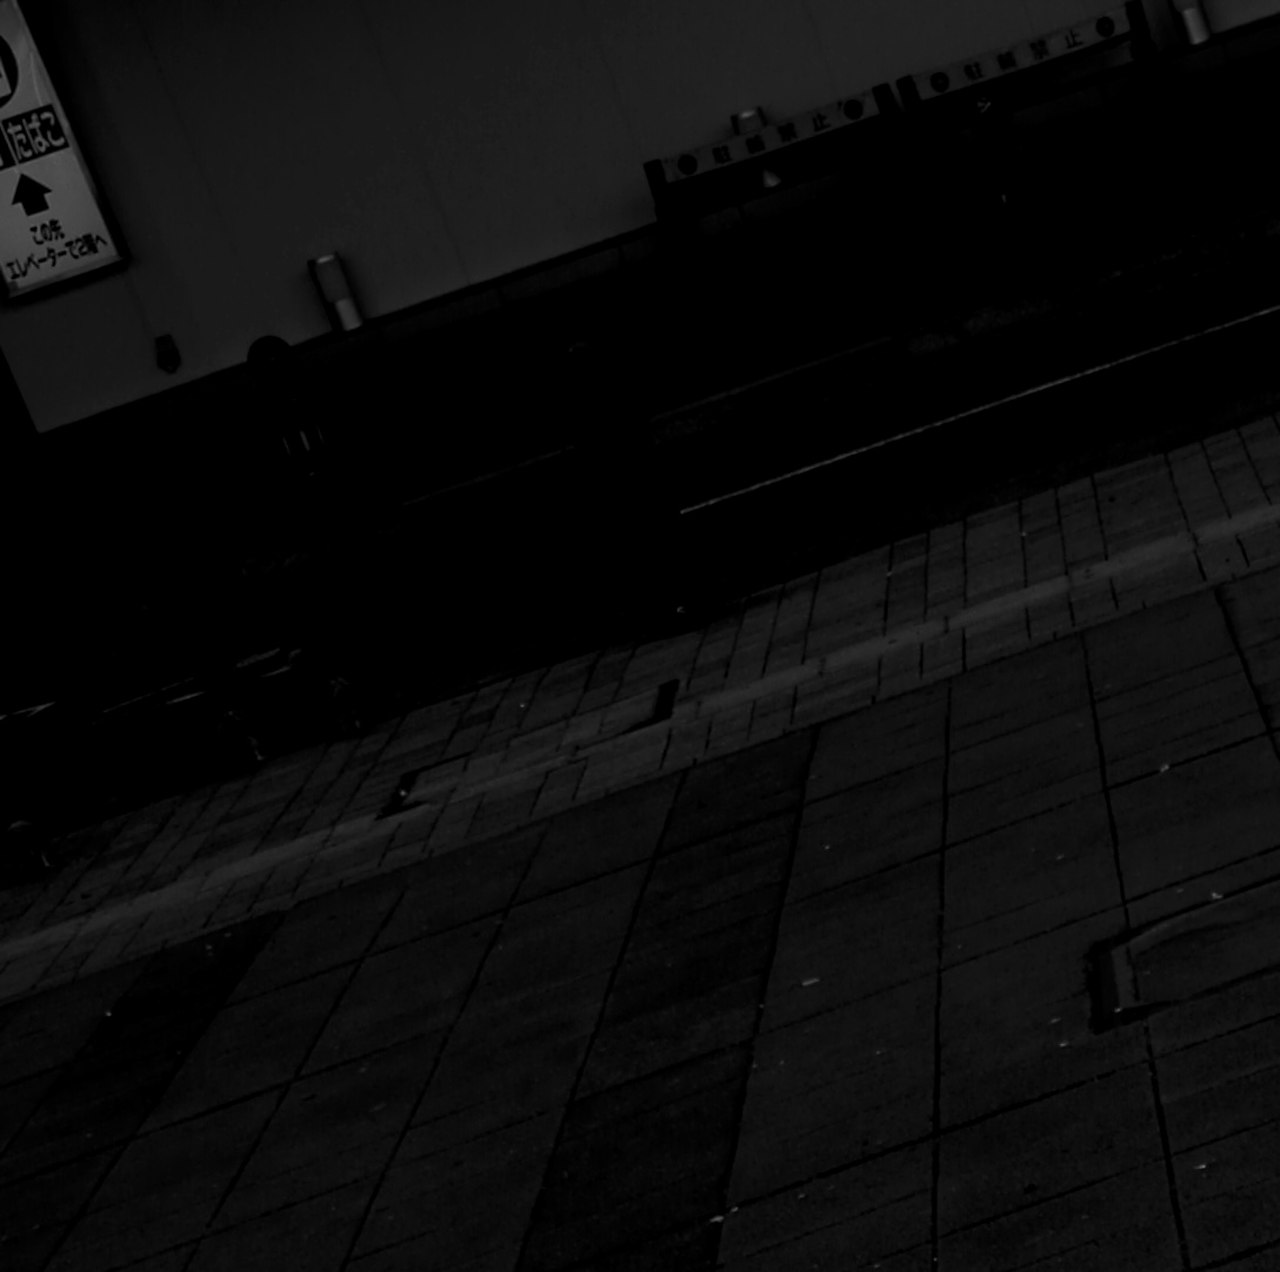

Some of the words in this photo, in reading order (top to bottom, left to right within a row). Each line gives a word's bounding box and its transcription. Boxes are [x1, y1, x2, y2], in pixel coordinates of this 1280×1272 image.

[7, 112, 65, 160] たばこ
[31, 220, 65, 245] この先
